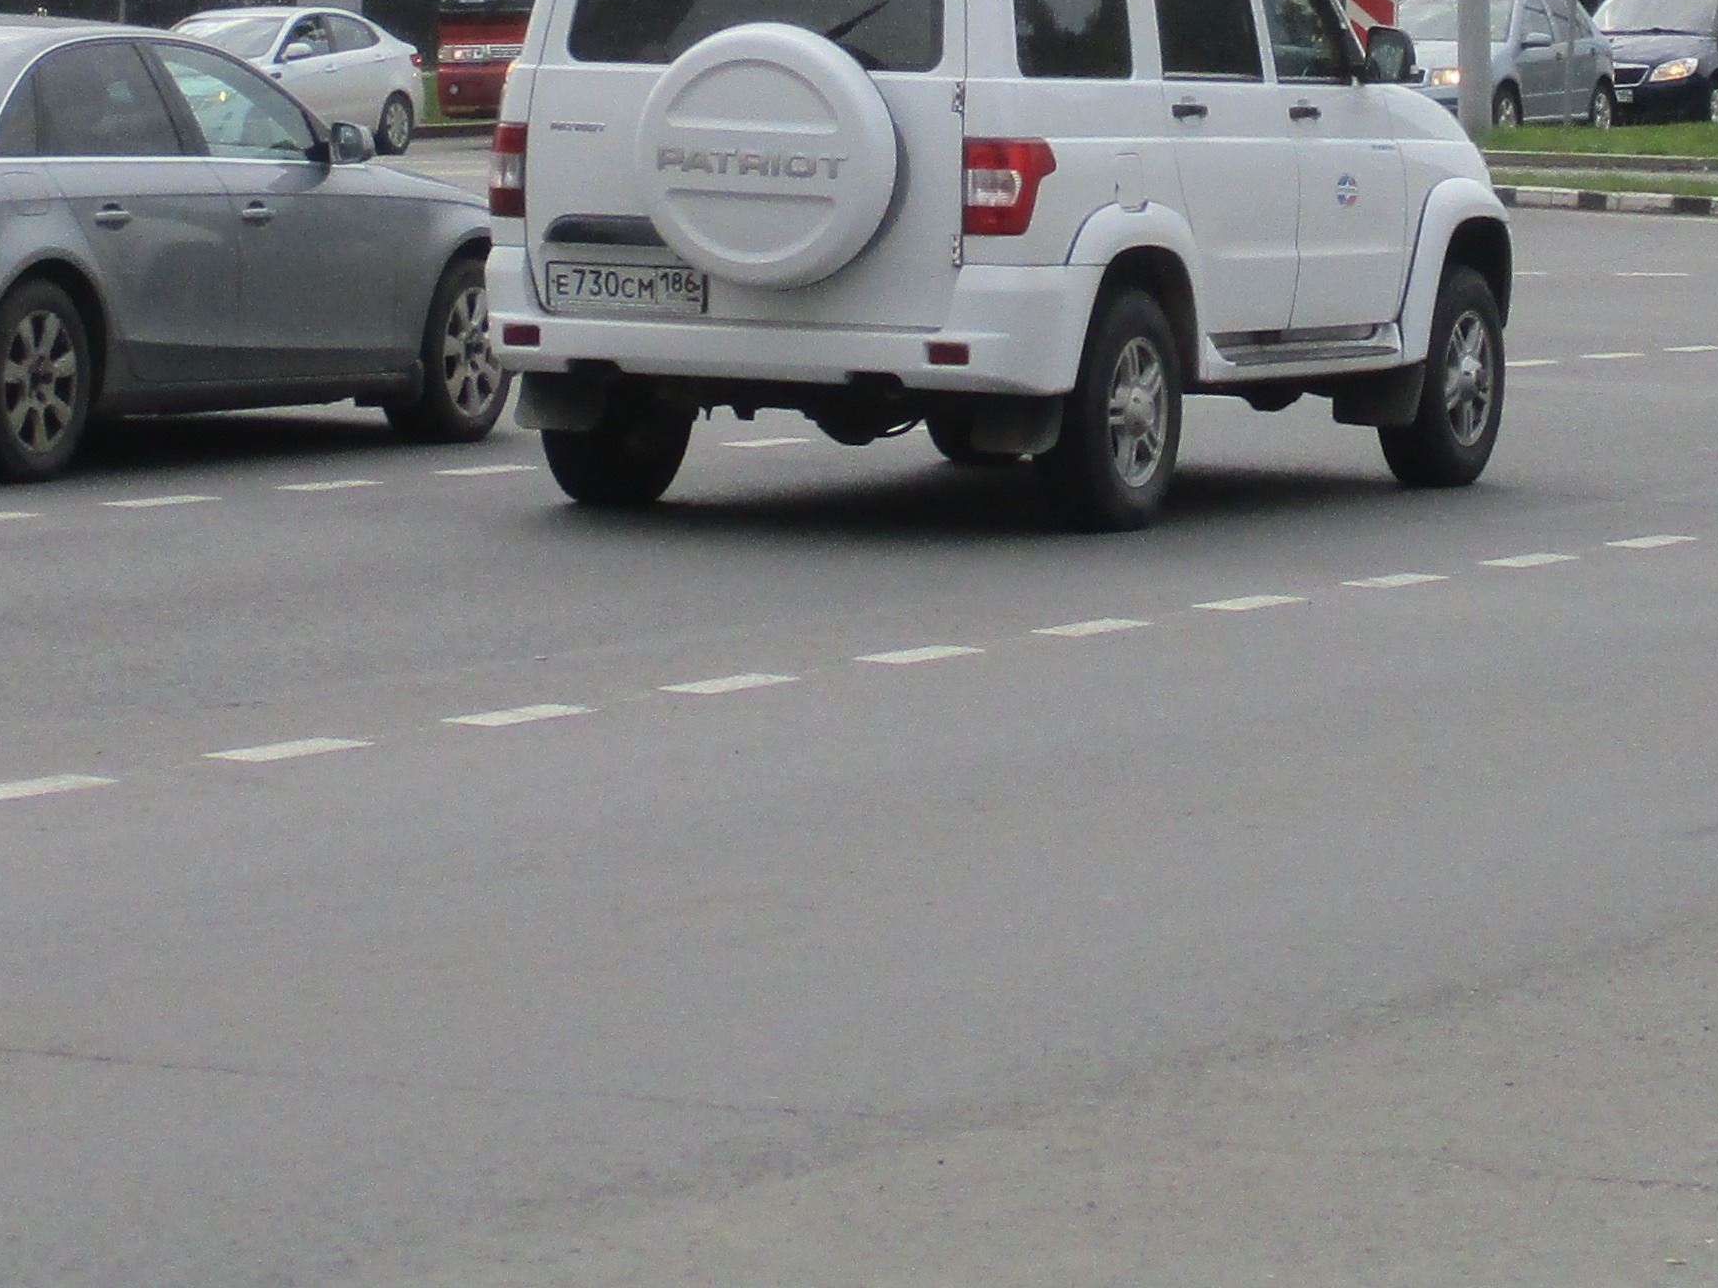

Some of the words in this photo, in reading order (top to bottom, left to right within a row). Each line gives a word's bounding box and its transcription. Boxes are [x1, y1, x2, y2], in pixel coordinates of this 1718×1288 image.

[656, 146, 849, 180] PATRIOT
[554, 270, 655, 301] Е730СМ
[659, 271, 700, 294] 186
